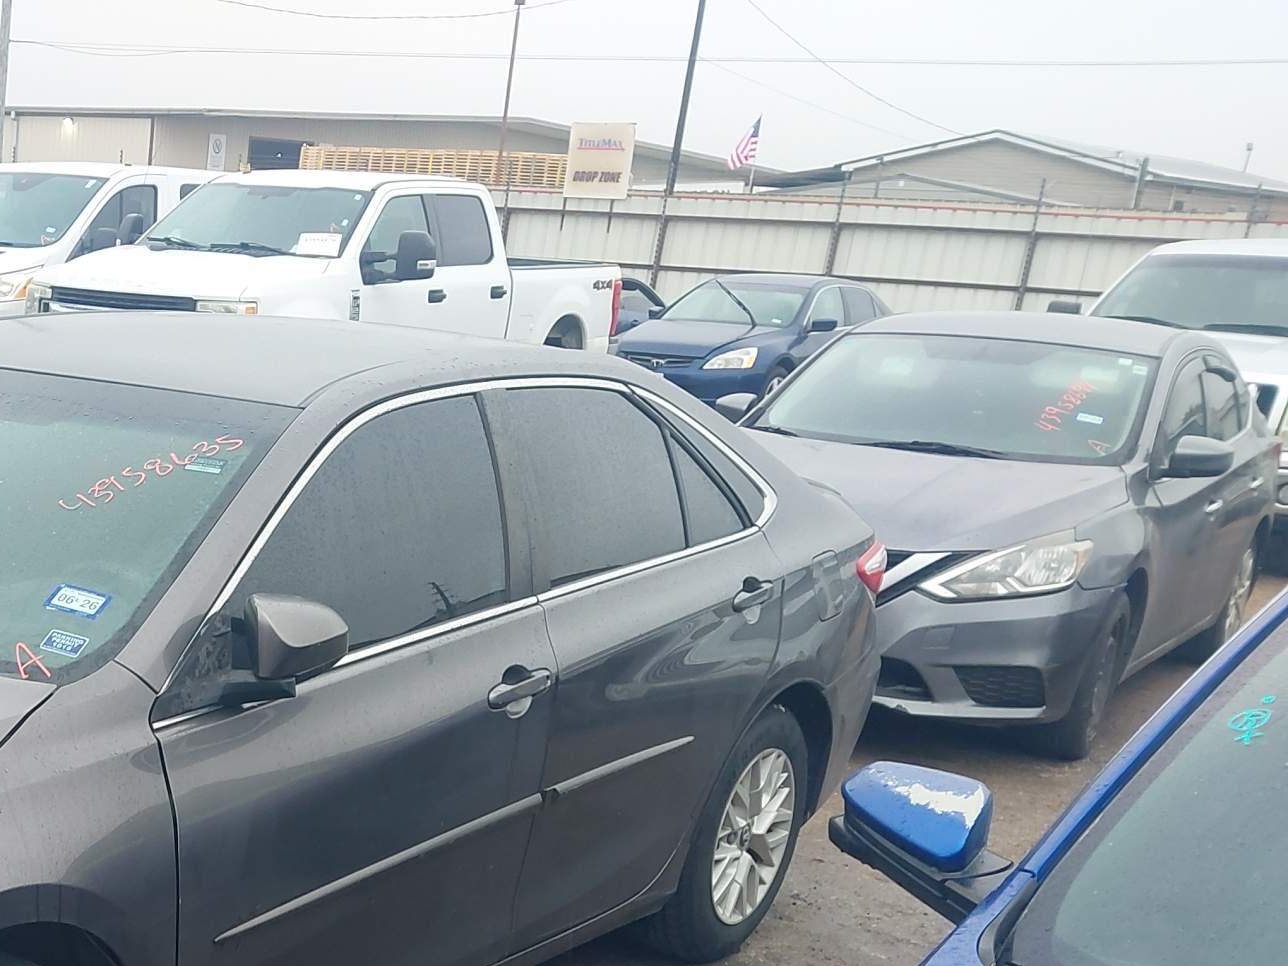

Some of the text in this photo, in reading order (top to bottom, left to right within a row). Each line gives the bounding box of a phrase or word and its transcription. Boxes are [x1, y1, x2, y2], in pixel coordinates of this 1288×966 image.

[572, 171, 623, 183] DROP ZONE
[58, 434, 244, 510] 43958635
[57, 592, 100, 611] 06 26
[13, 640, 53, 680] A
